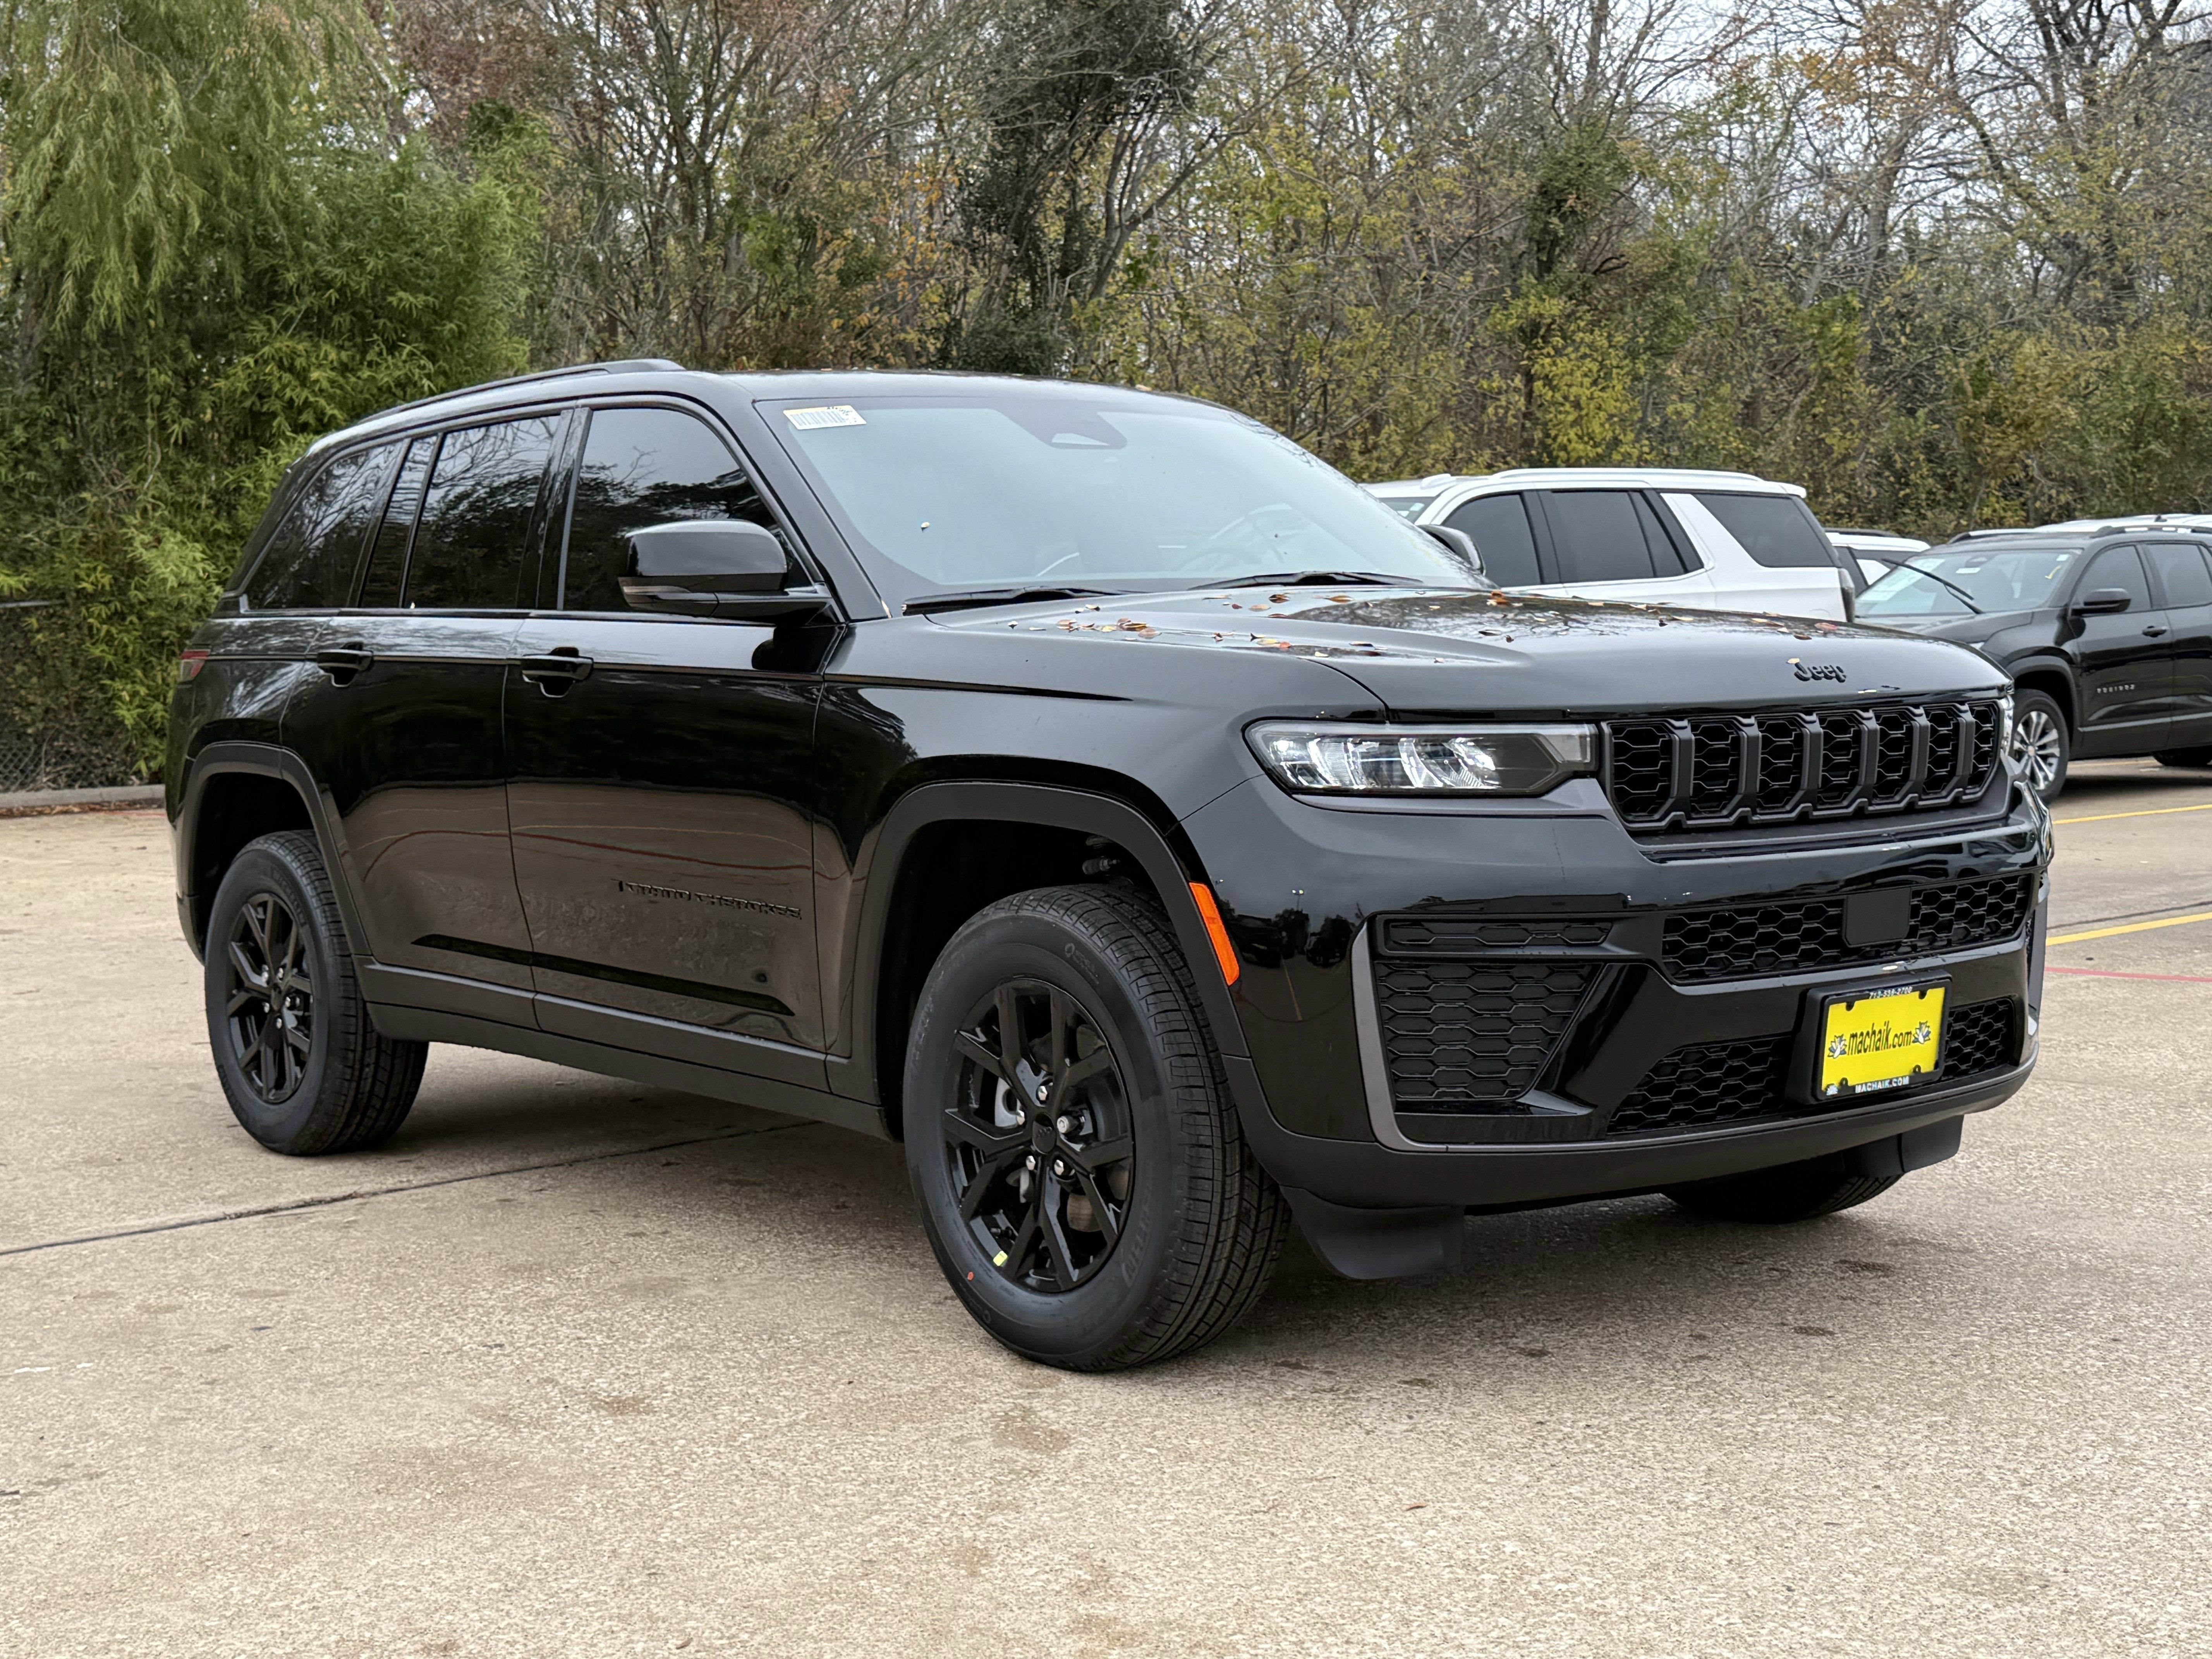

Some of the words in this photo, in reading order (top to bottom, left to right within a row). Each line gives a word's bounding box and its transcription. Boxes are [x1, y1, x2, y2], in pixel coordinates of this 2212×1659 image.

[1794, 662, 1846, 683] Jeep
[1847, 1020, 1912, 1056] machaik.com
[1855, 1076, 1910, 1094] MACHAIK.COM
